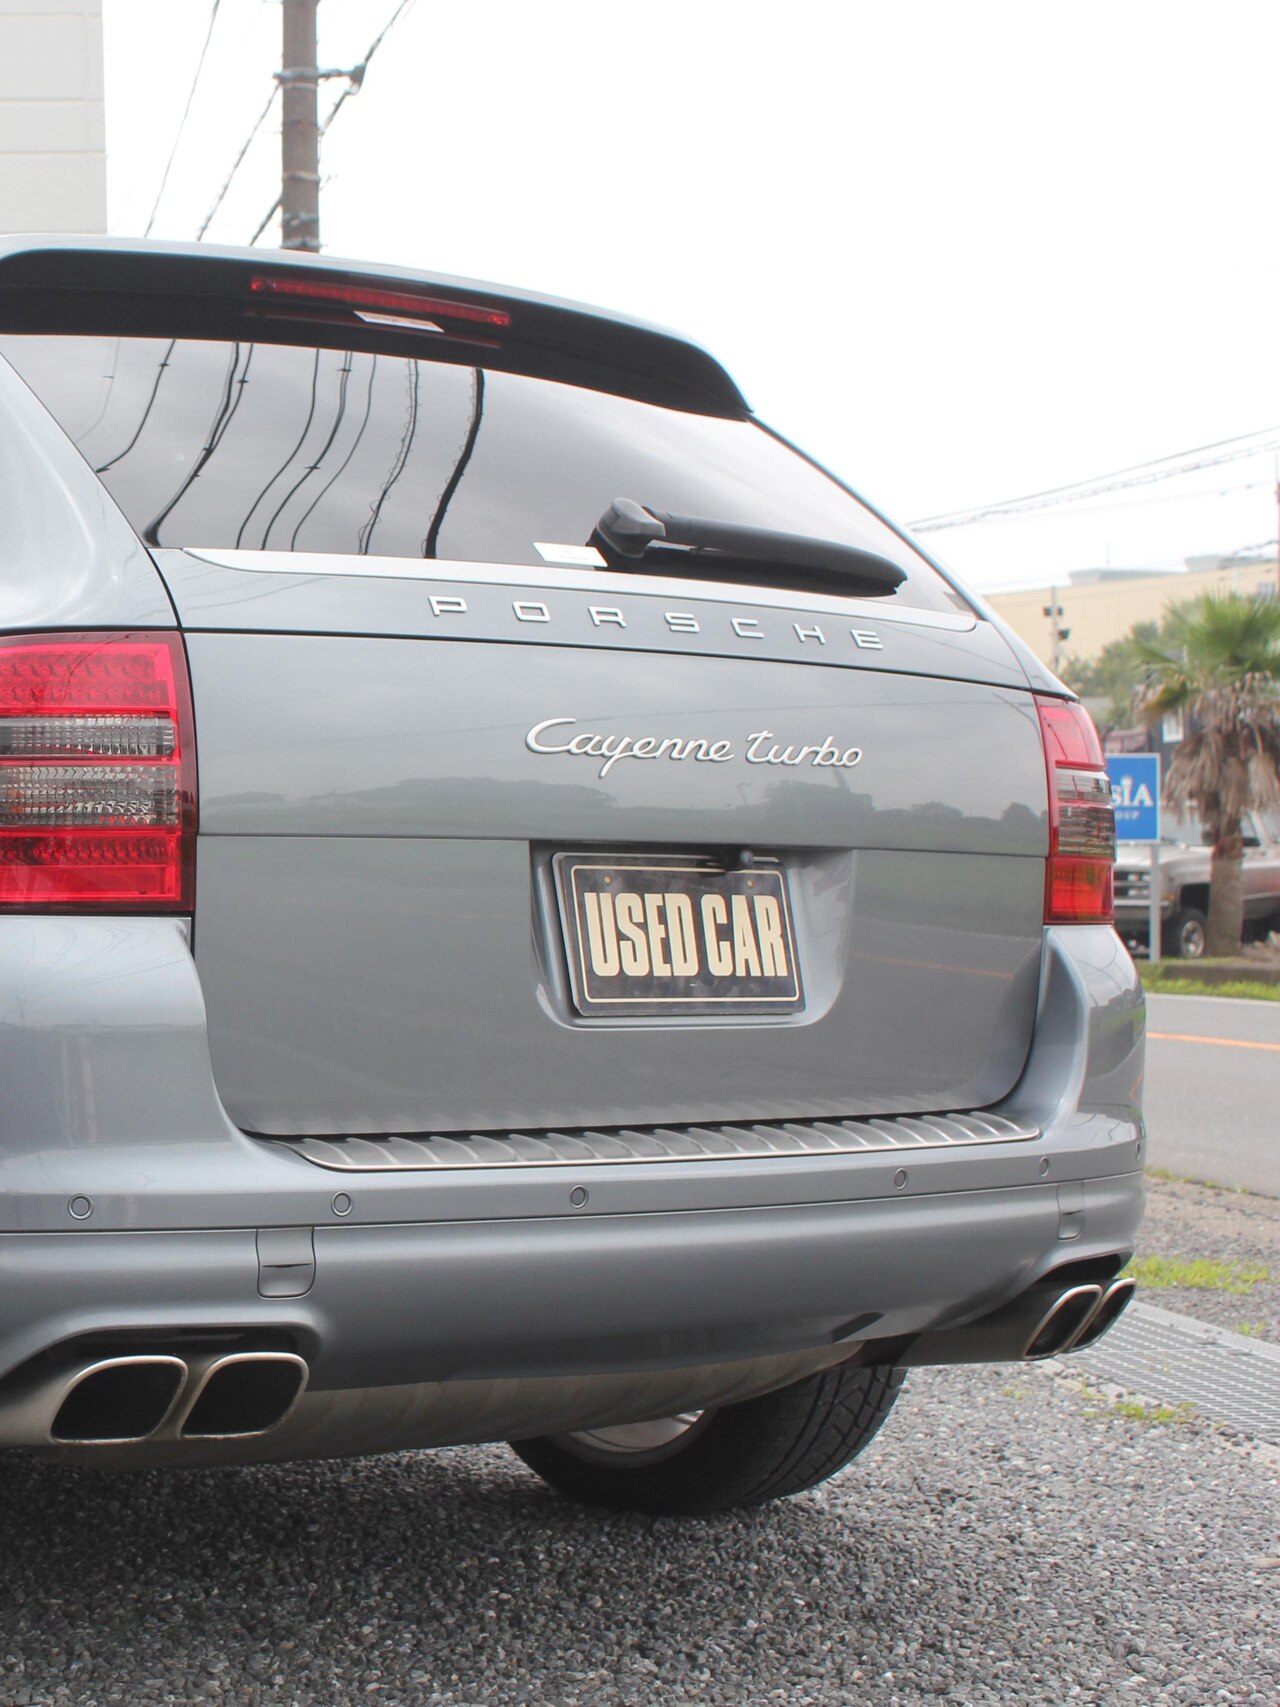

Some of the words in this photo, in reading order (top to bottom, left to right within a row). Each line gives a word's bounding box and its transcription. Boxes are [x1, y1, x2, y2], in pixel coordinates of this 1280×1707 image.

[427, 594, 884, 650] PORSCHE
[525, 717, 735, 778] Cayenne
[583, 892, 699, 976] USED
[700, 893, 788, 976] CAR
